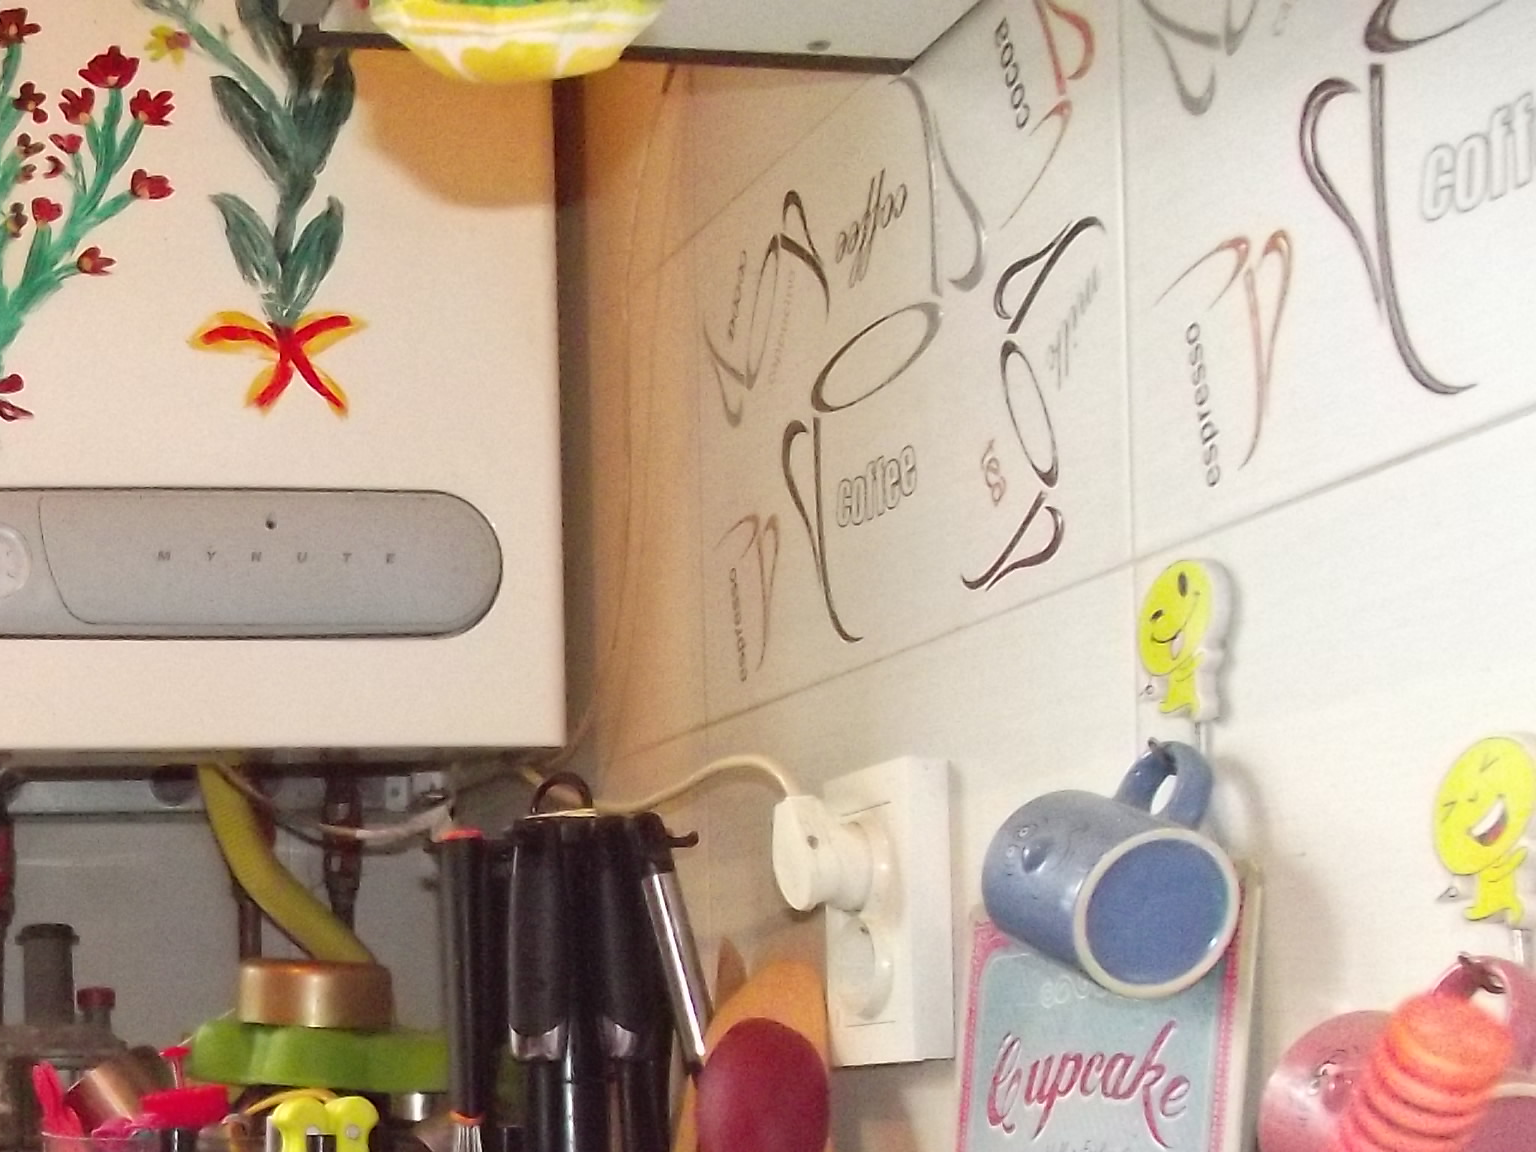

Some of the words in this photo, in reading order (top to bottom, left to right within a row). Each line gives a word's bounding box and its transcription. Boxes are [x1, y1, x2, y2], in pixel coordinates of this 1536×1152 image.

[995, 16, 1031, 129] cocoa
[1419, 91, 1536, 223] coff
[834, 167, 909, 290] coffee
[1184, 321, 1222, 488] espresso
[835, 444, 918, 528] coffee
[157, 551, 395, 564] MYNUTE
[986, 1019, 1192, 1150] Cupcake
